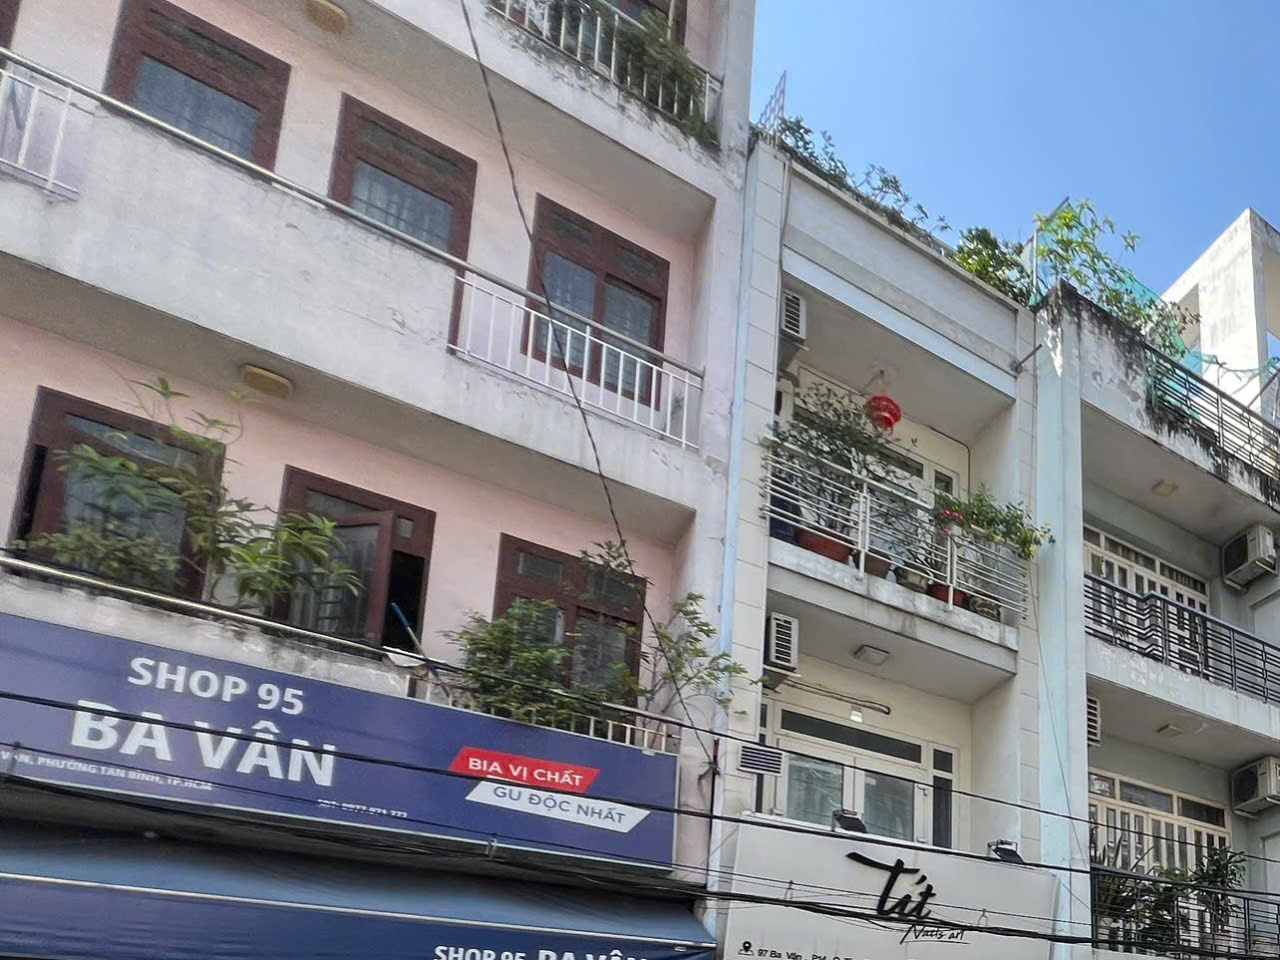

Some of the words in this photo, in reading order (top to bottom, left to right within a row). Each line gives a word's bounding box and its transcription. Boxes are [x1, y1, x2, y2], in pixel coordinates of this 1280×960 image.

[128, 657, 247, 702] SHOP
[257, 683, 304, 715] 95
[71, 699, 173, 761] BA
[194, 719, 336, 787] VÂN
[468, 757, 502, 774] BIA
[509, 763, 528, 781] VỊ
[533, 769, 584, 787] CHẤT
[493, 786, 522, 801] GU
[528, 793, 571, 812] ĐỘC
[577, 803, 626, 824] NHẤT
[757, 948, 768, 957] 97
[770, 950, 782, 959] Ba
